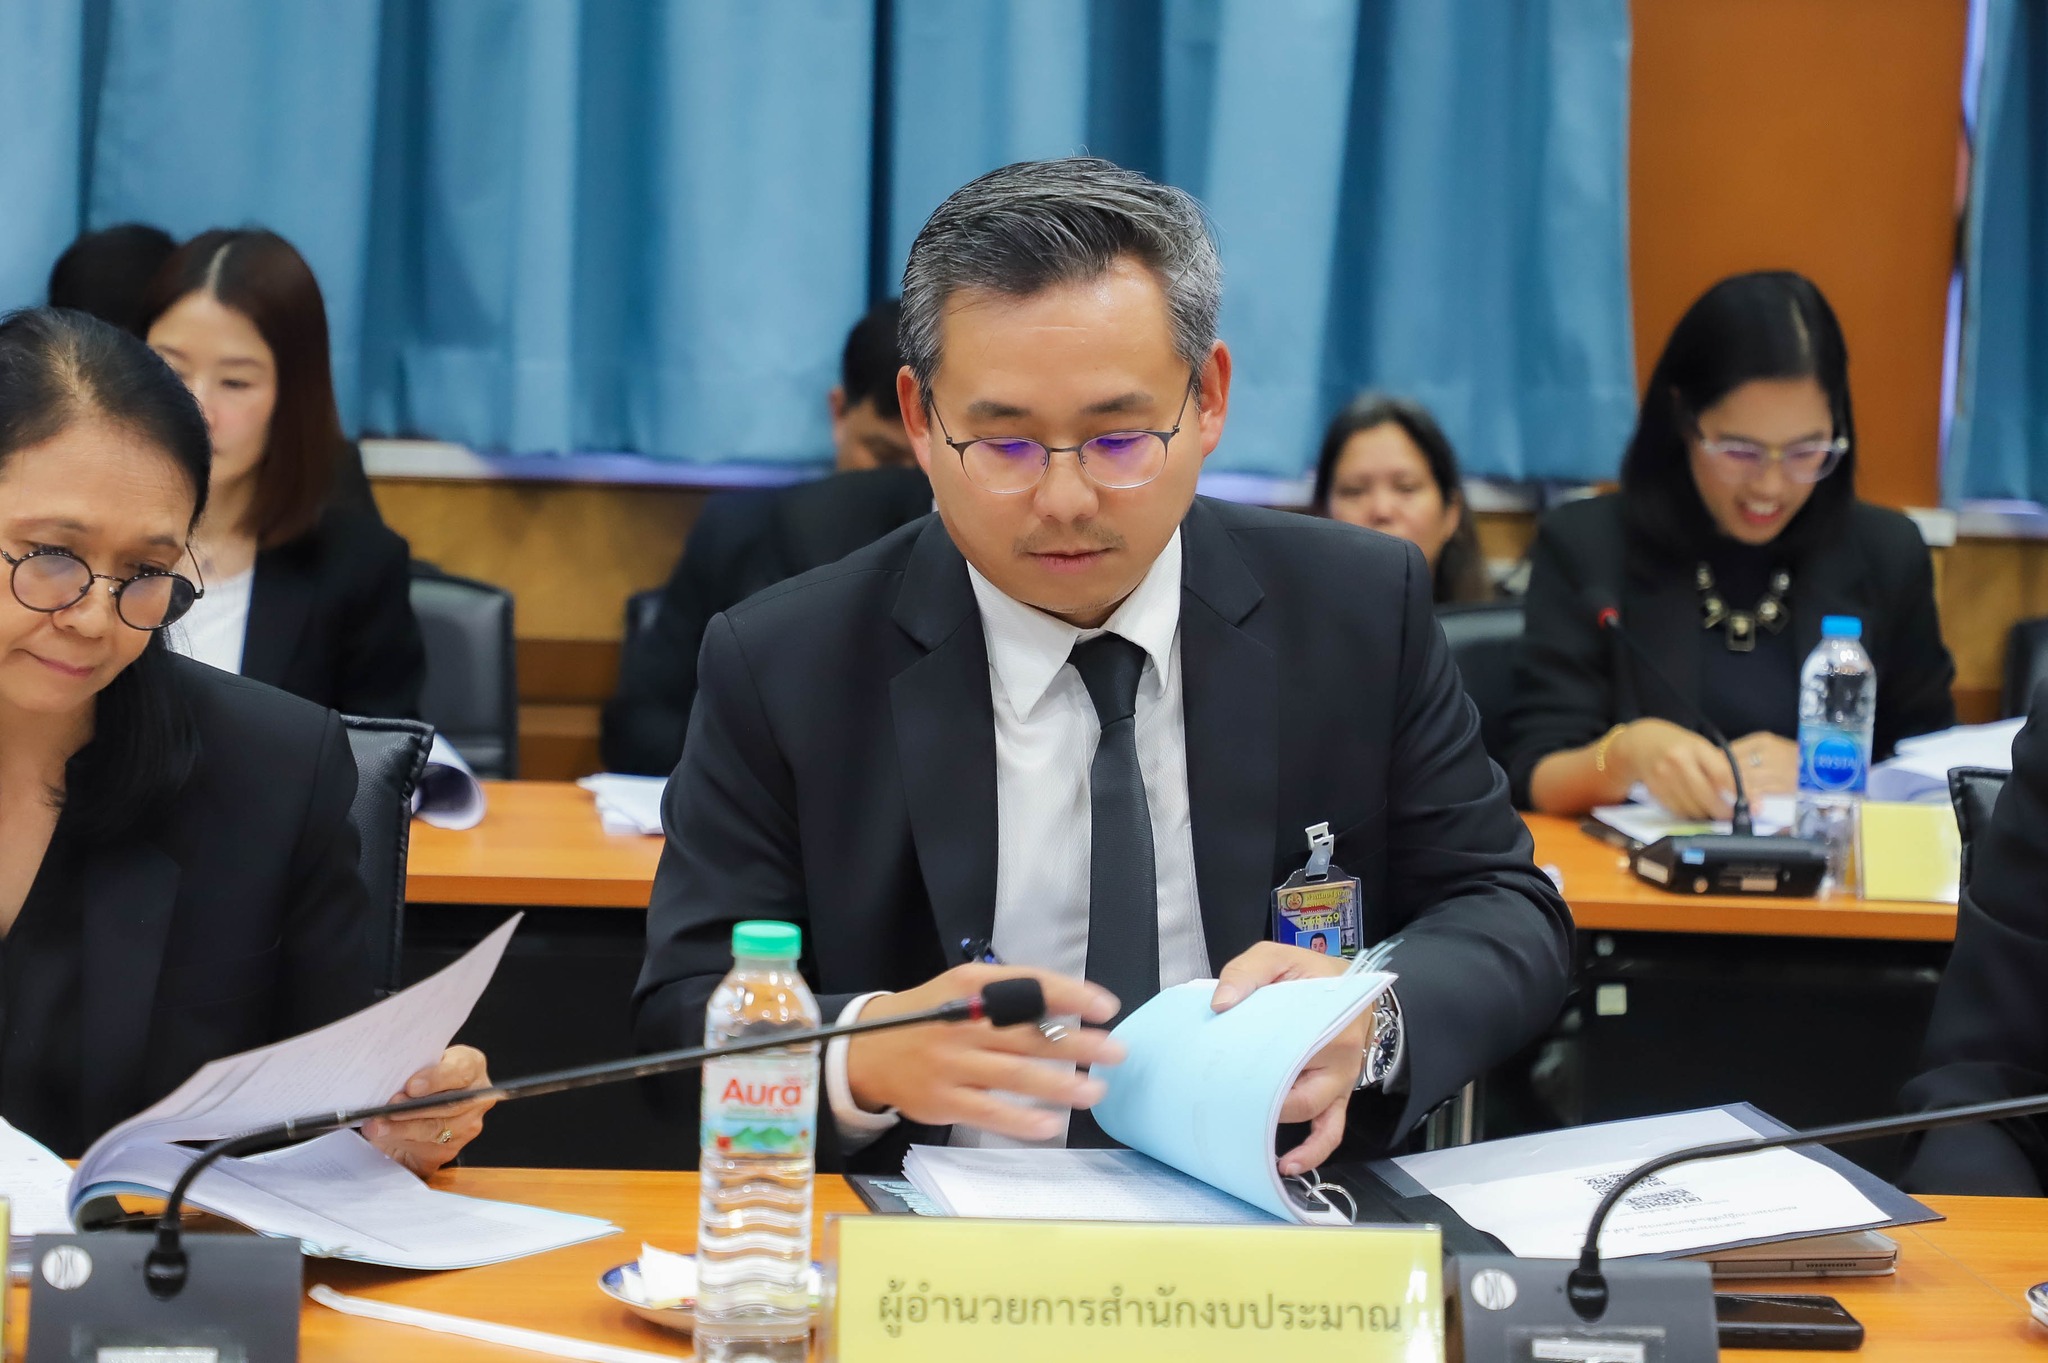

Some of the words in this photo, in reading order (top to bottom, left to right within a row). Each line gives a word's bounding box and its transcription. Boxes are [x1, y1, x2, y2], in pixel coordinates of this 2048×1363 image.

[720, 1078, 802, 1106] Aura
[879, 1279, 1402, 1338] ผู้อำนวยการสำนักงบประมาณ
